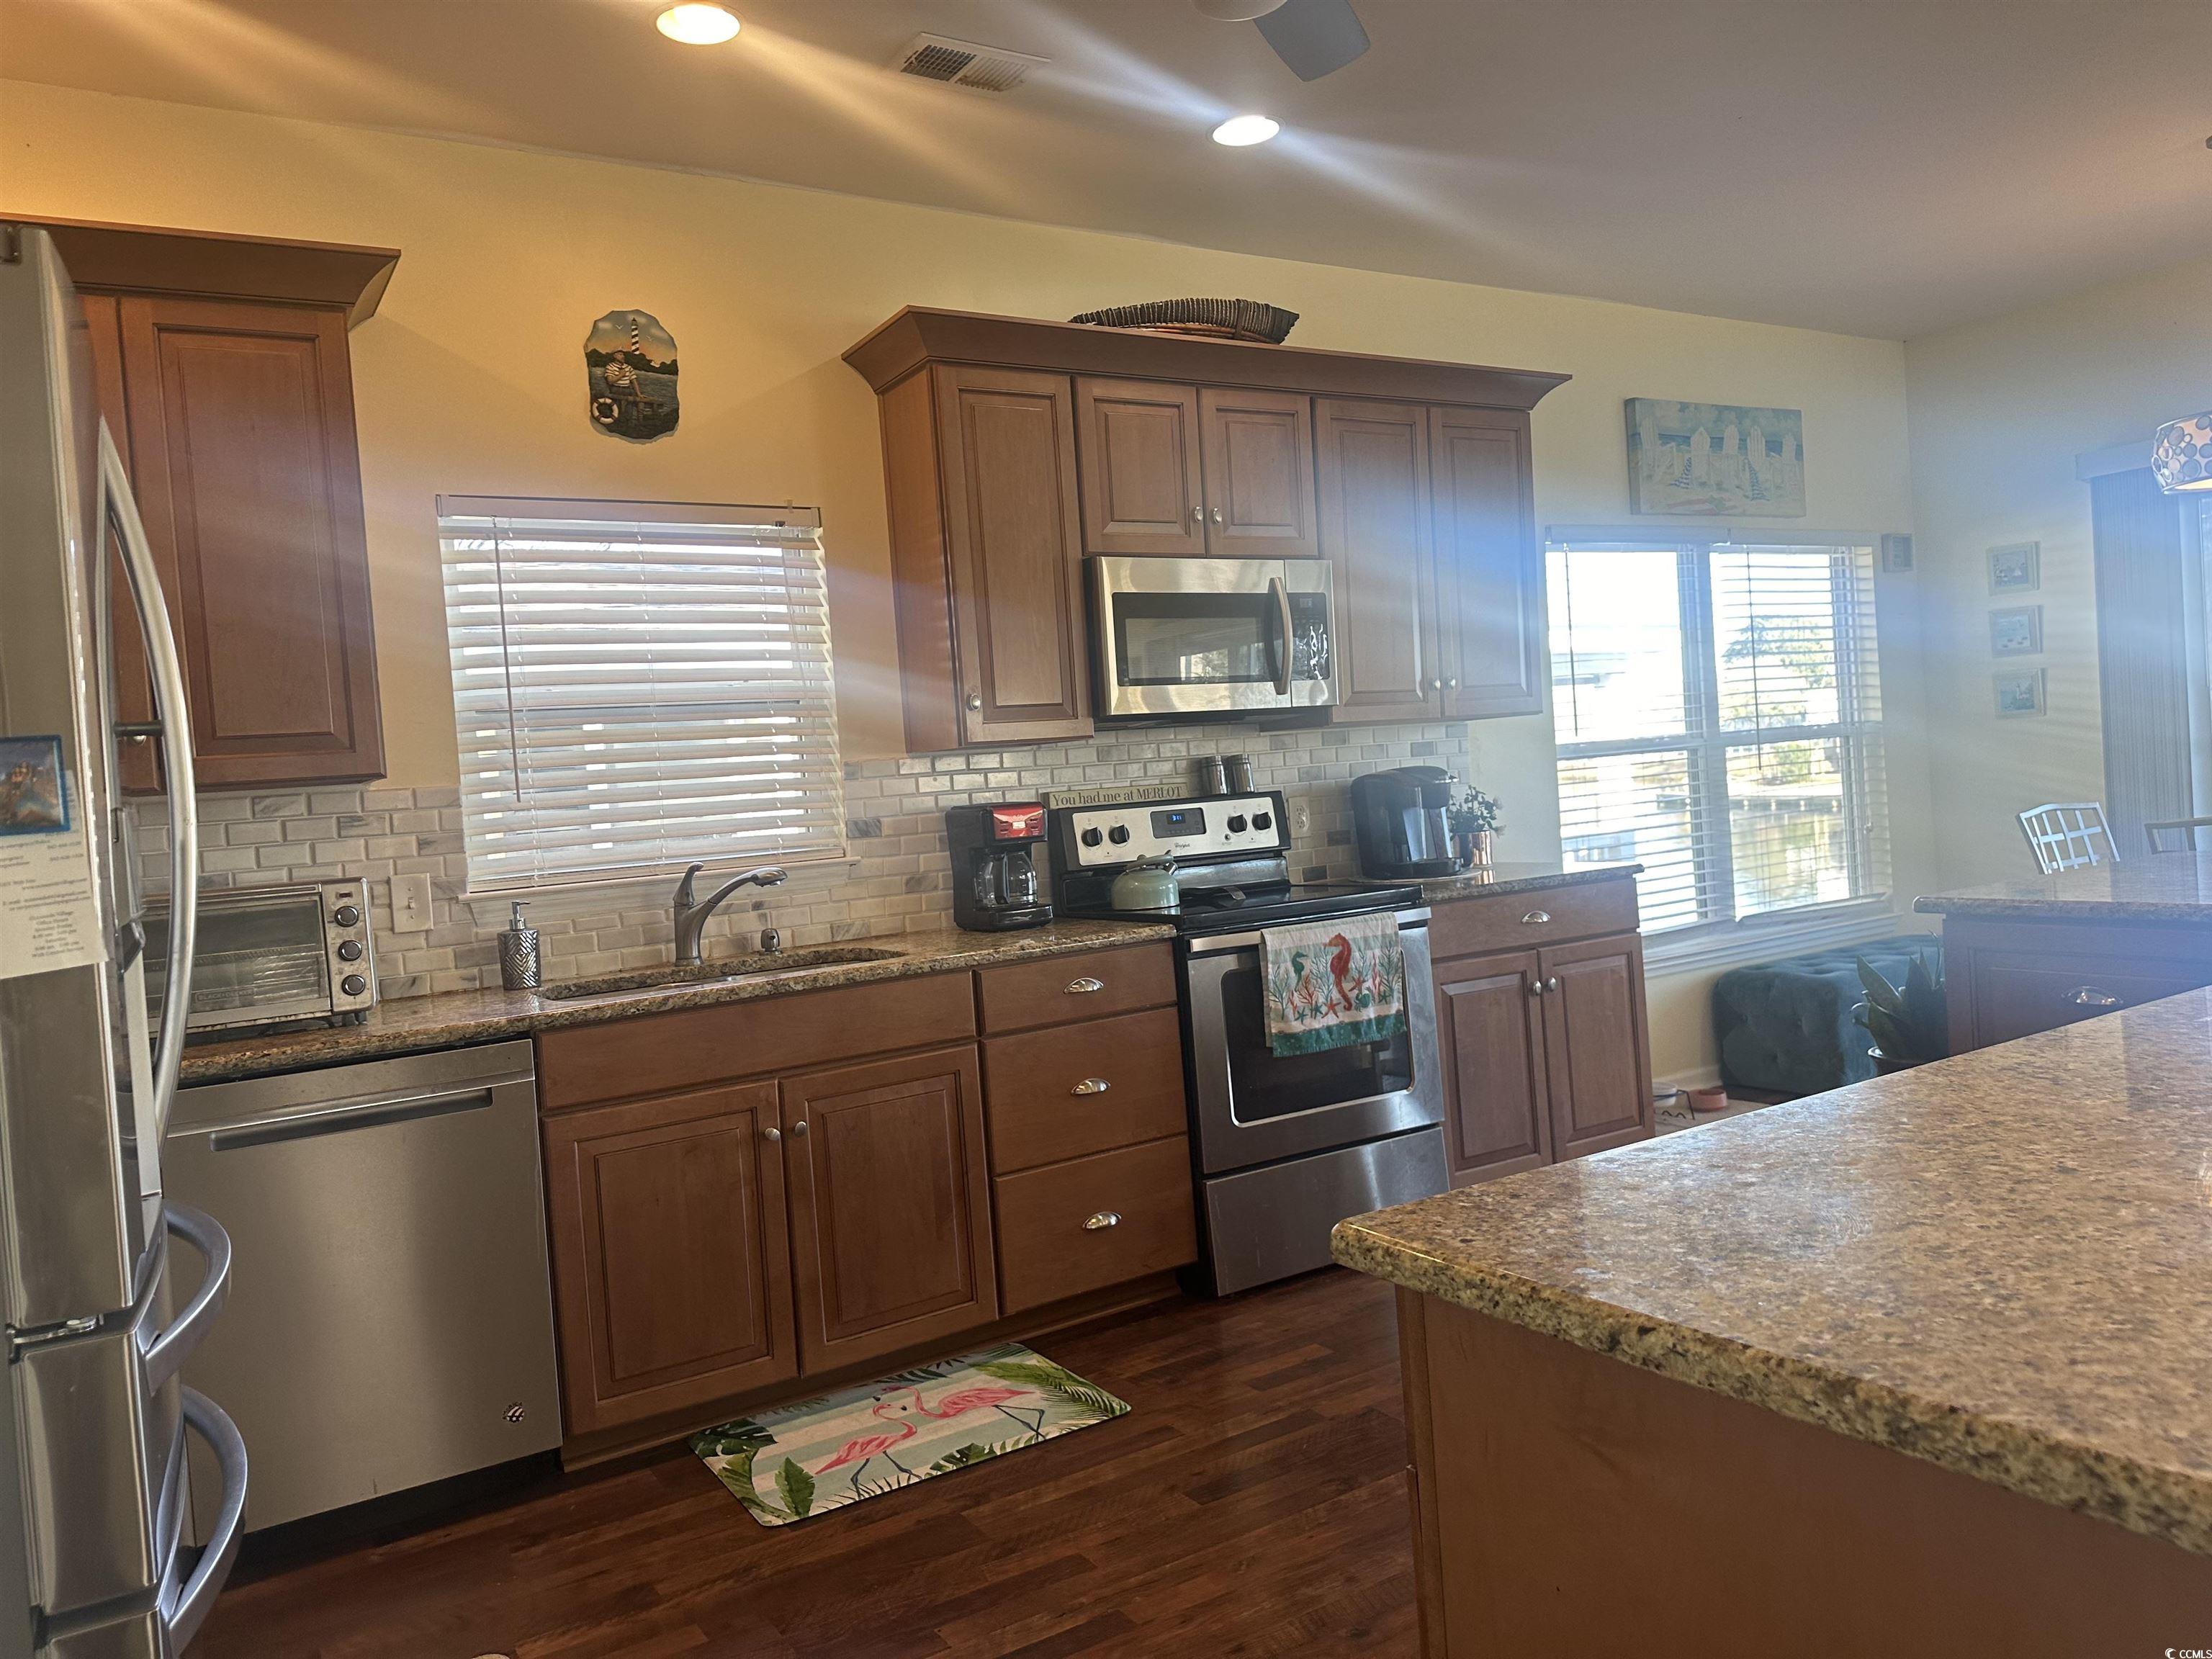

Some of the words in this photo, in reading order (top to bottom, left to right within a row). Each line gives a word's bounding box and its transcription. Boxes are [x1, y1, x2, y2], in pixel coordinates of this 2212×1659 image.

[1053, 794, 1076, 806] You
[1078, 791, 1101, 804] had
[1102, 792, 1121, 802] me
[1123, 791, 1134, 801] at
[1137, 786, 1182, 800] MERLOT
